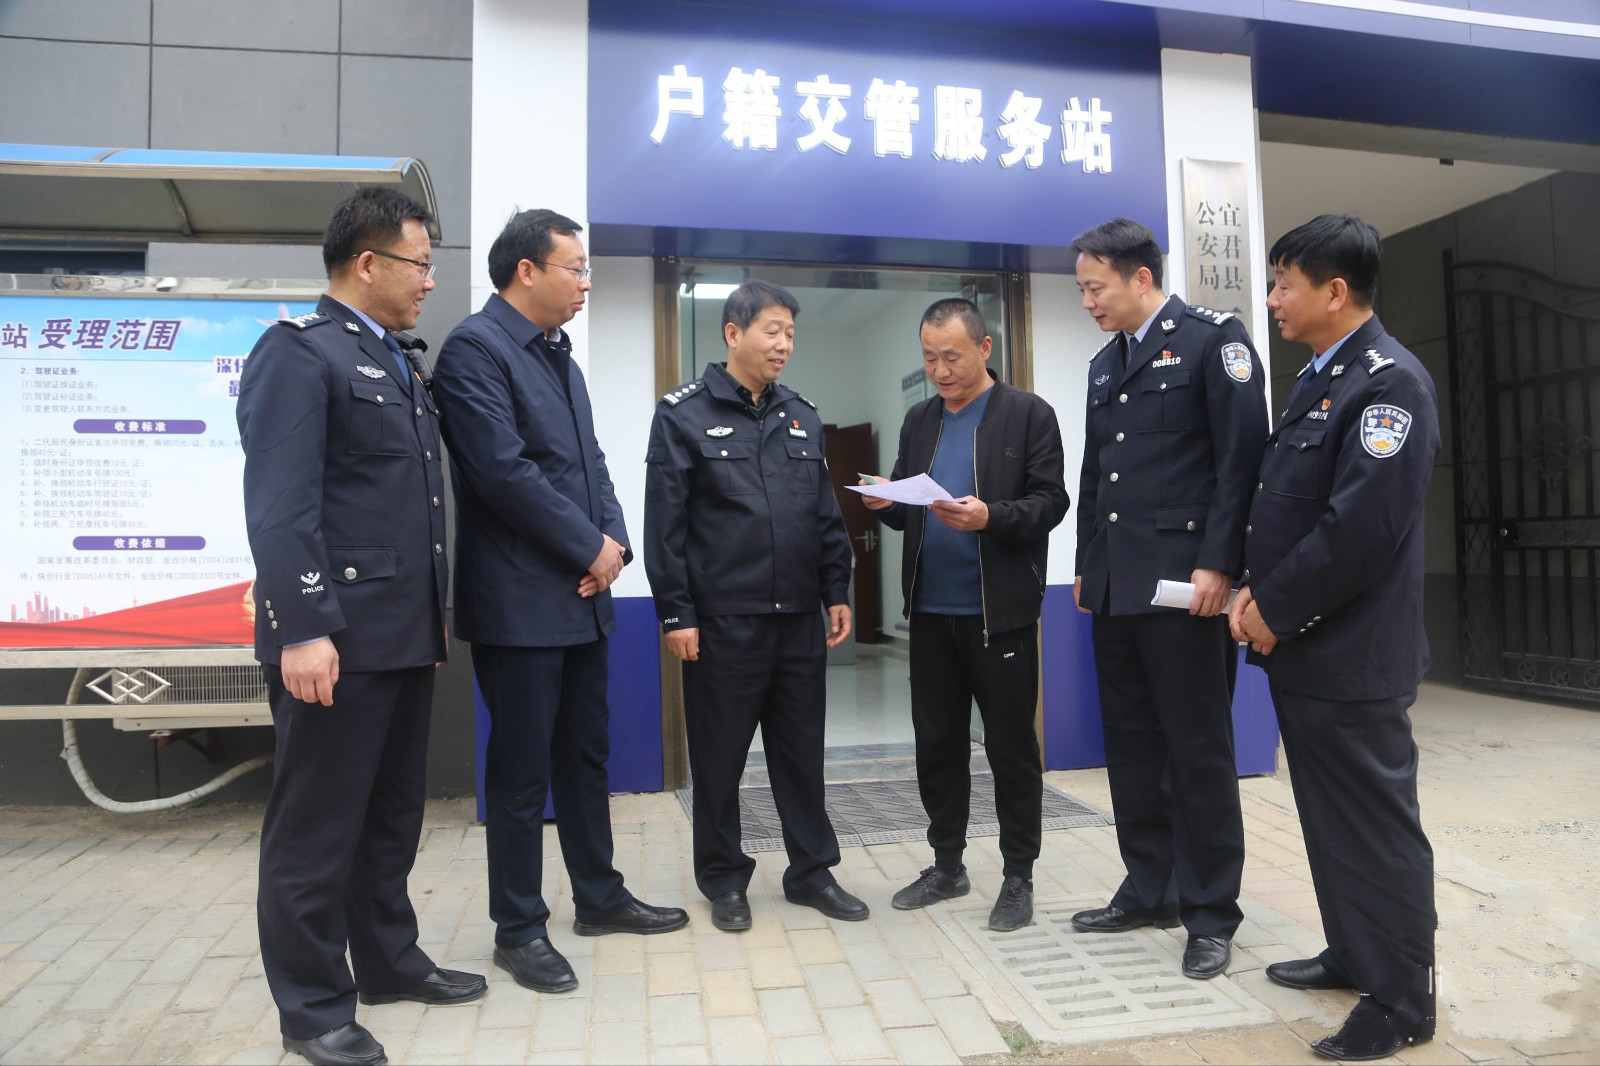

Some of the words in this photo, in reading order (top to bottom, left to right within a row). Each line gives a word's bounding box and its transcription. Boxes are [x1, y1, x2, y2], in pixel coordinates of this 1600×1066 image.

[650, 65, 1112, 173] 户籍交管服务站
[1196, 201, 1219, 290] 公安局
[1219, 203, 1243, 290] 宜君县
[2, 324, 28, 349] 站
[38, 318, 181, 351] 受理范围
[1152, 357, 1181, 368] 008810
[114, 421, 166, 432] 收费标准
[114, 537, 166, 549] 收费依据
[302, 585, 324, 595] POLICE
